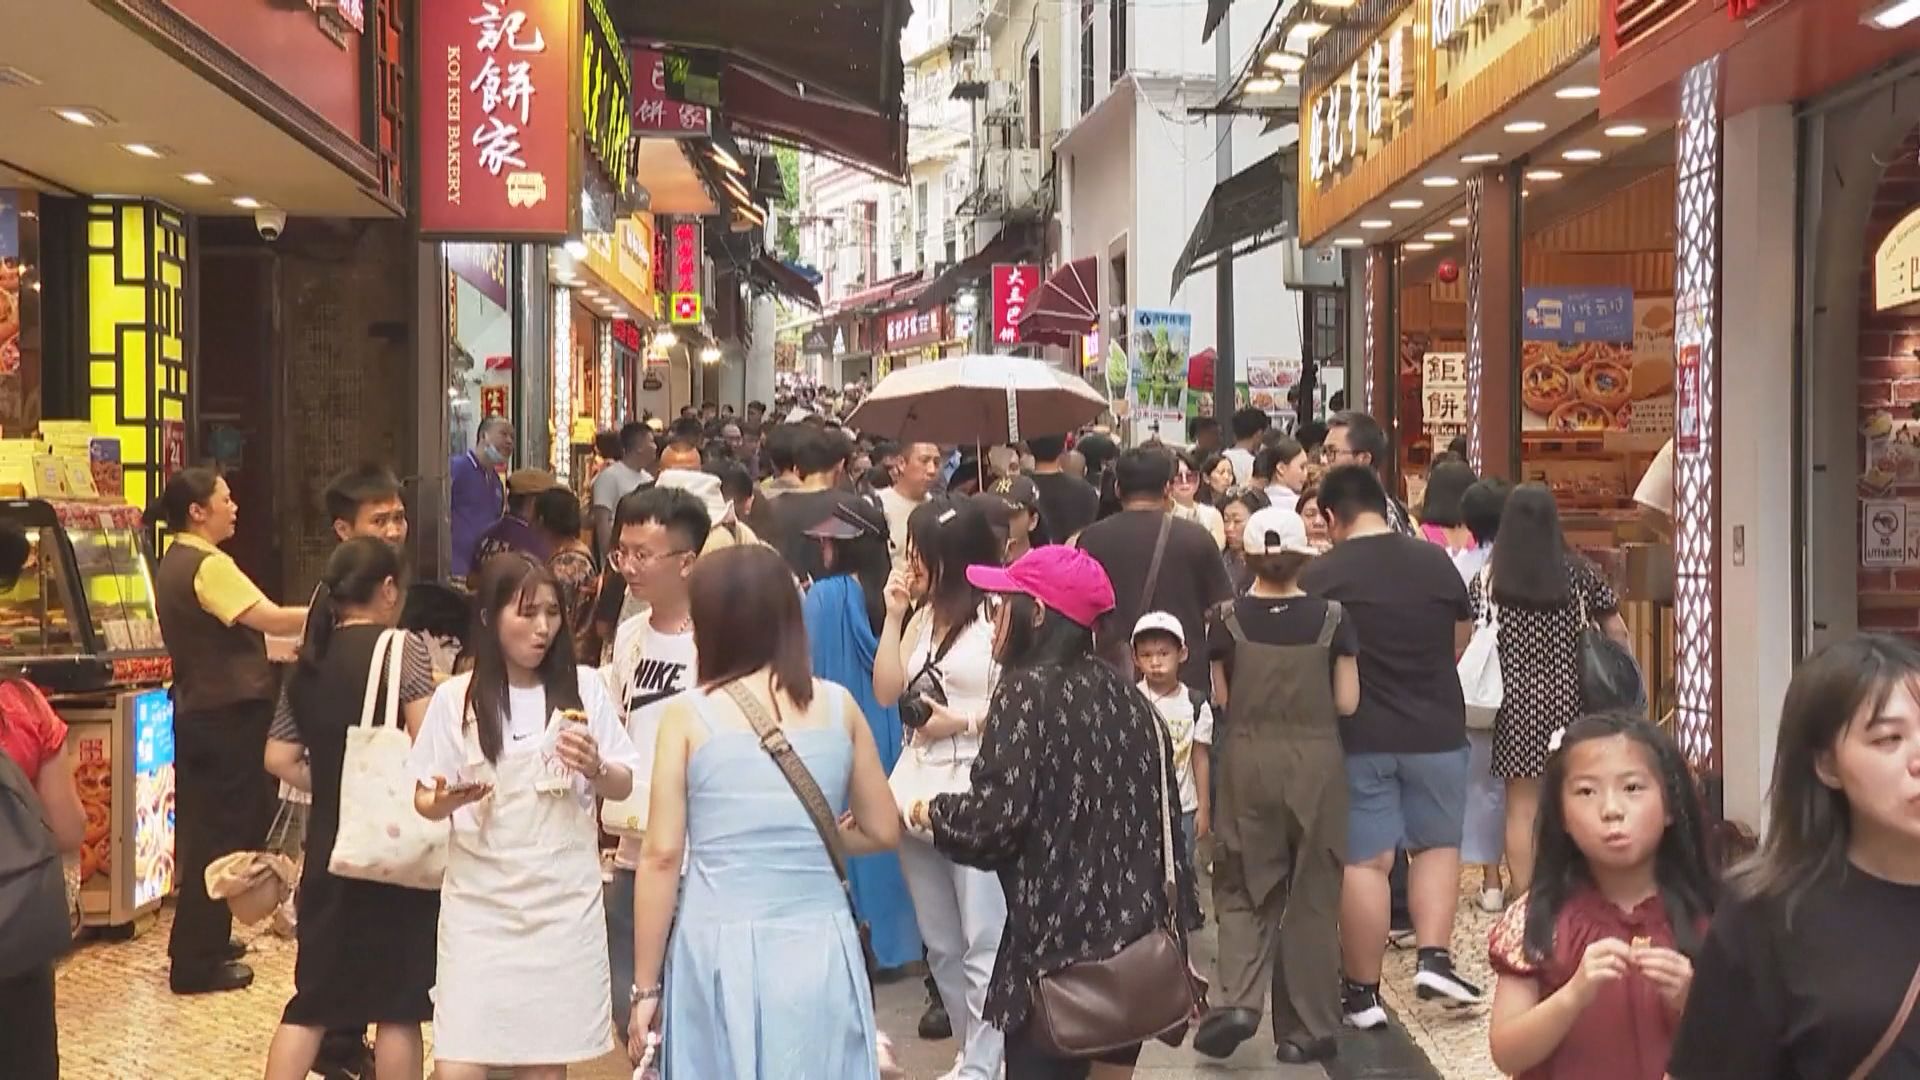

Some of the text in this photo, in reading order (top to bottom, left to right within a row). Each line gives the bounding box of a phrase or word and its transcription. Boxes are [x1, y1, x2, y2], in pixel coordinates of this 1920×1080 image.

[469, 0, 545, 175] 記餅家
[448, 46, 460, 205] KOI KEI BAKERY
[1427, 356, 1466, 382] 鉅
[1427, 391, 1466, 419] 餅
[1880, 537, 1891, 546] NO
[634, 659, 687, 691] NIKE
